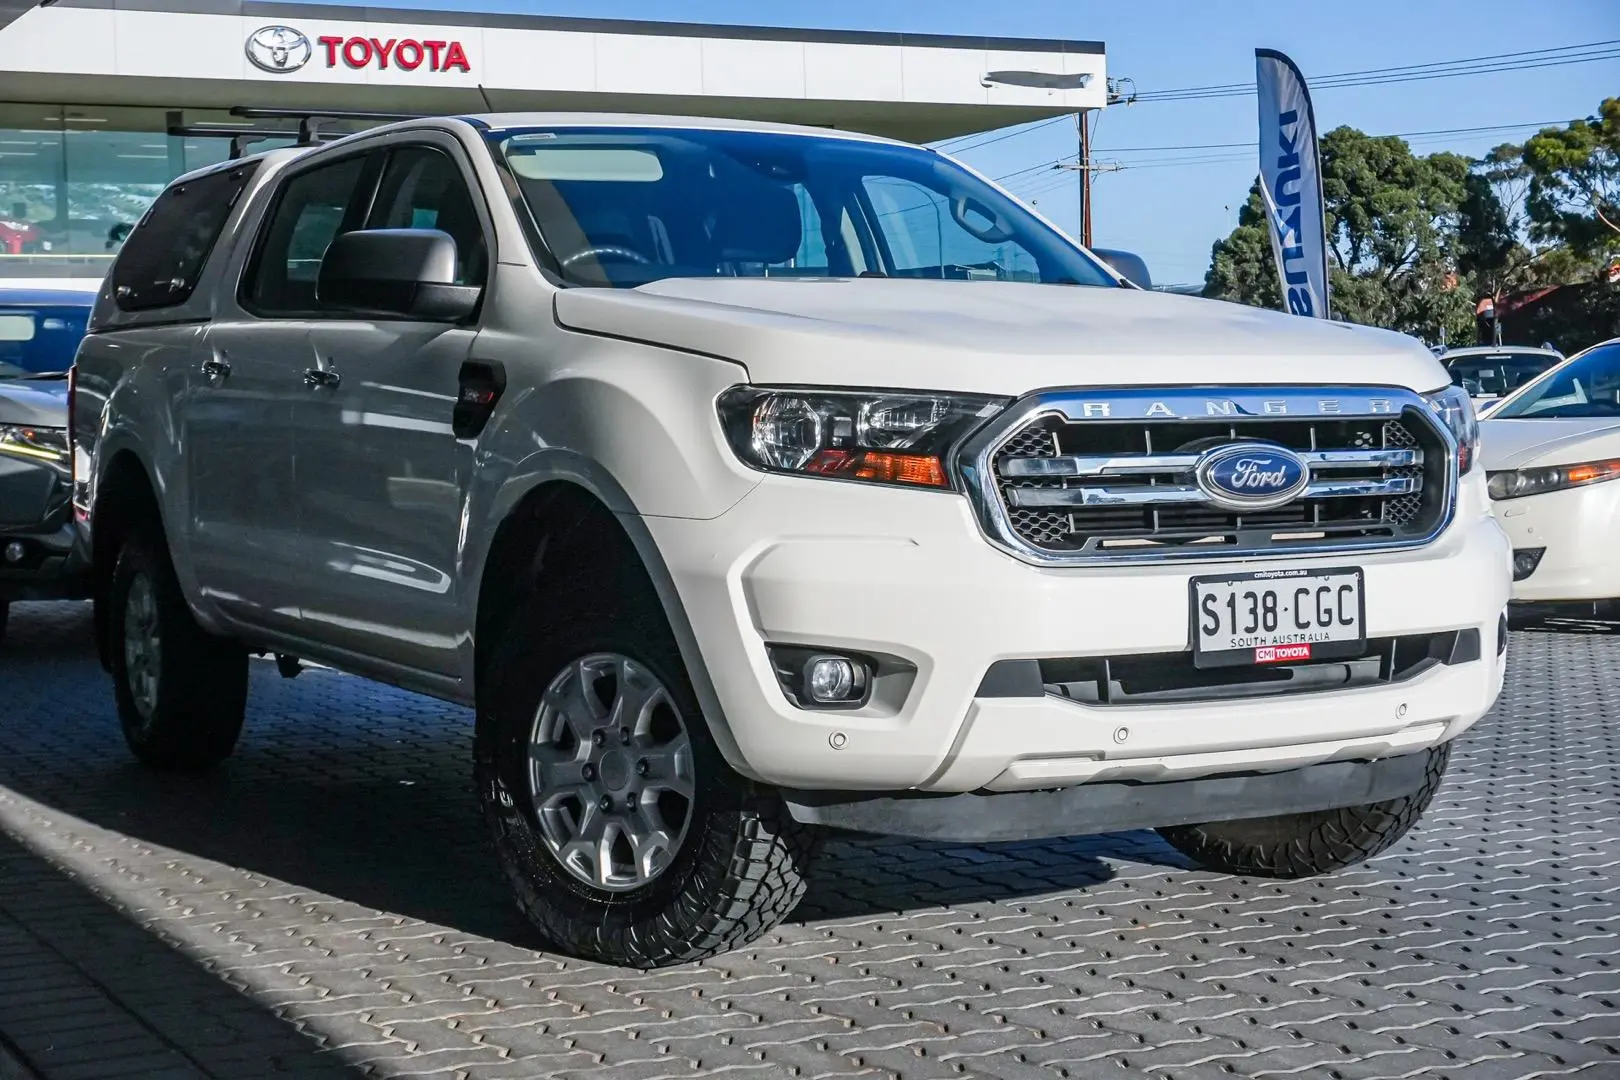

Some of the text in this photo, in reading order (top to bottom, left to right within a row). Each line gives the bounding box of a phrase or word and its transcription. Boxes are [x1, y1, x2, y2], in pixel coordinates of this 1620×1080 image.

[319, 36, 471, 71] TOYOTA
[1083, 400, 1394, 417] RANGER
[1231, 458, 1286, 488] Ford
[1254, 569, 1308, 579] cmitoyota.com.au
[1230, 632, 1330, 648] SOUTH AUSTRALIA
[1257, 646, 1310, 660] CMI TOYOTA
